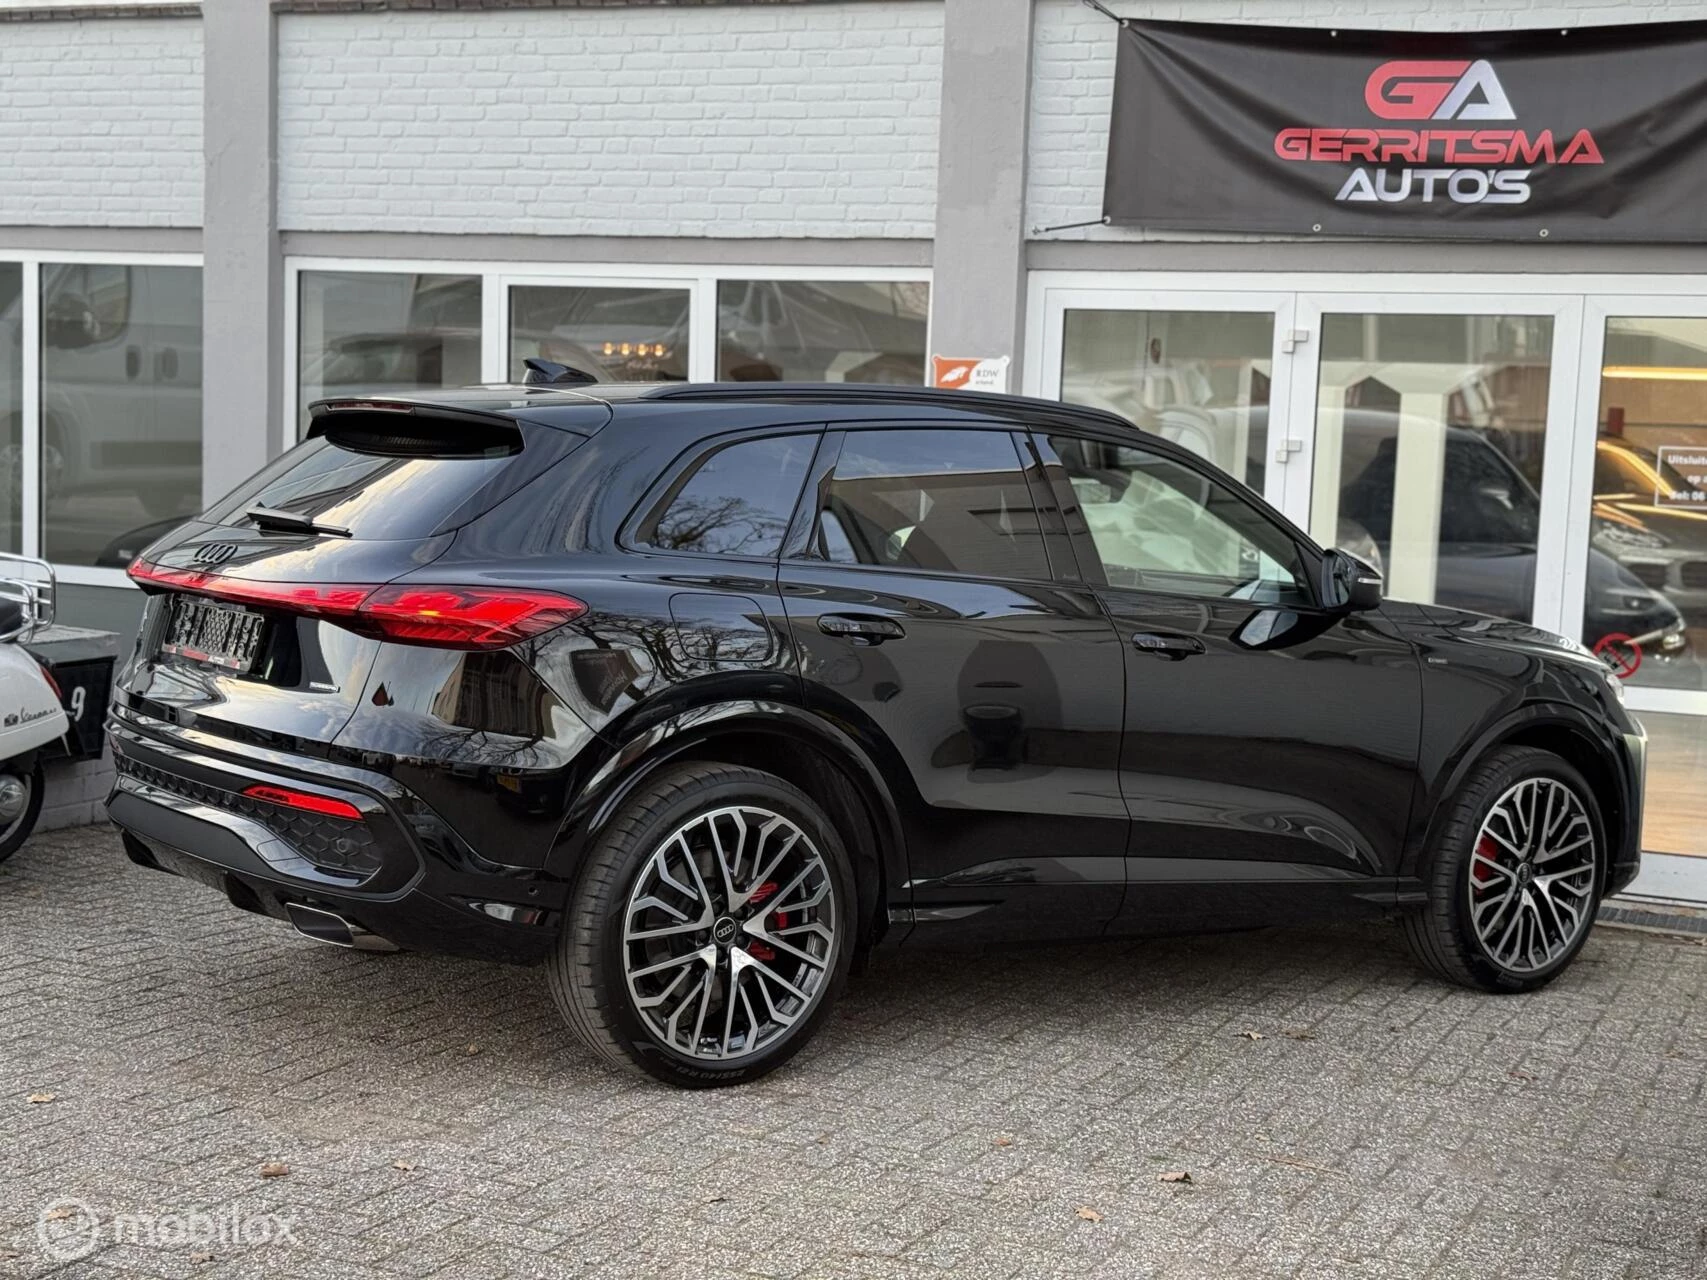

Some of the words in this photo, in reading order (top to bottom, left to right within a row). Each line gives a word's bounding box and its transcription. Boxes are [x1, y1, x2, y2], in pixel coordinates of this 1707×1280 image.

[1365, 59, 1517, 120] GA
[1274, 128, 1604, 164] GERRITSMA
[1335, 167, 1532, 204] AUTO'S
